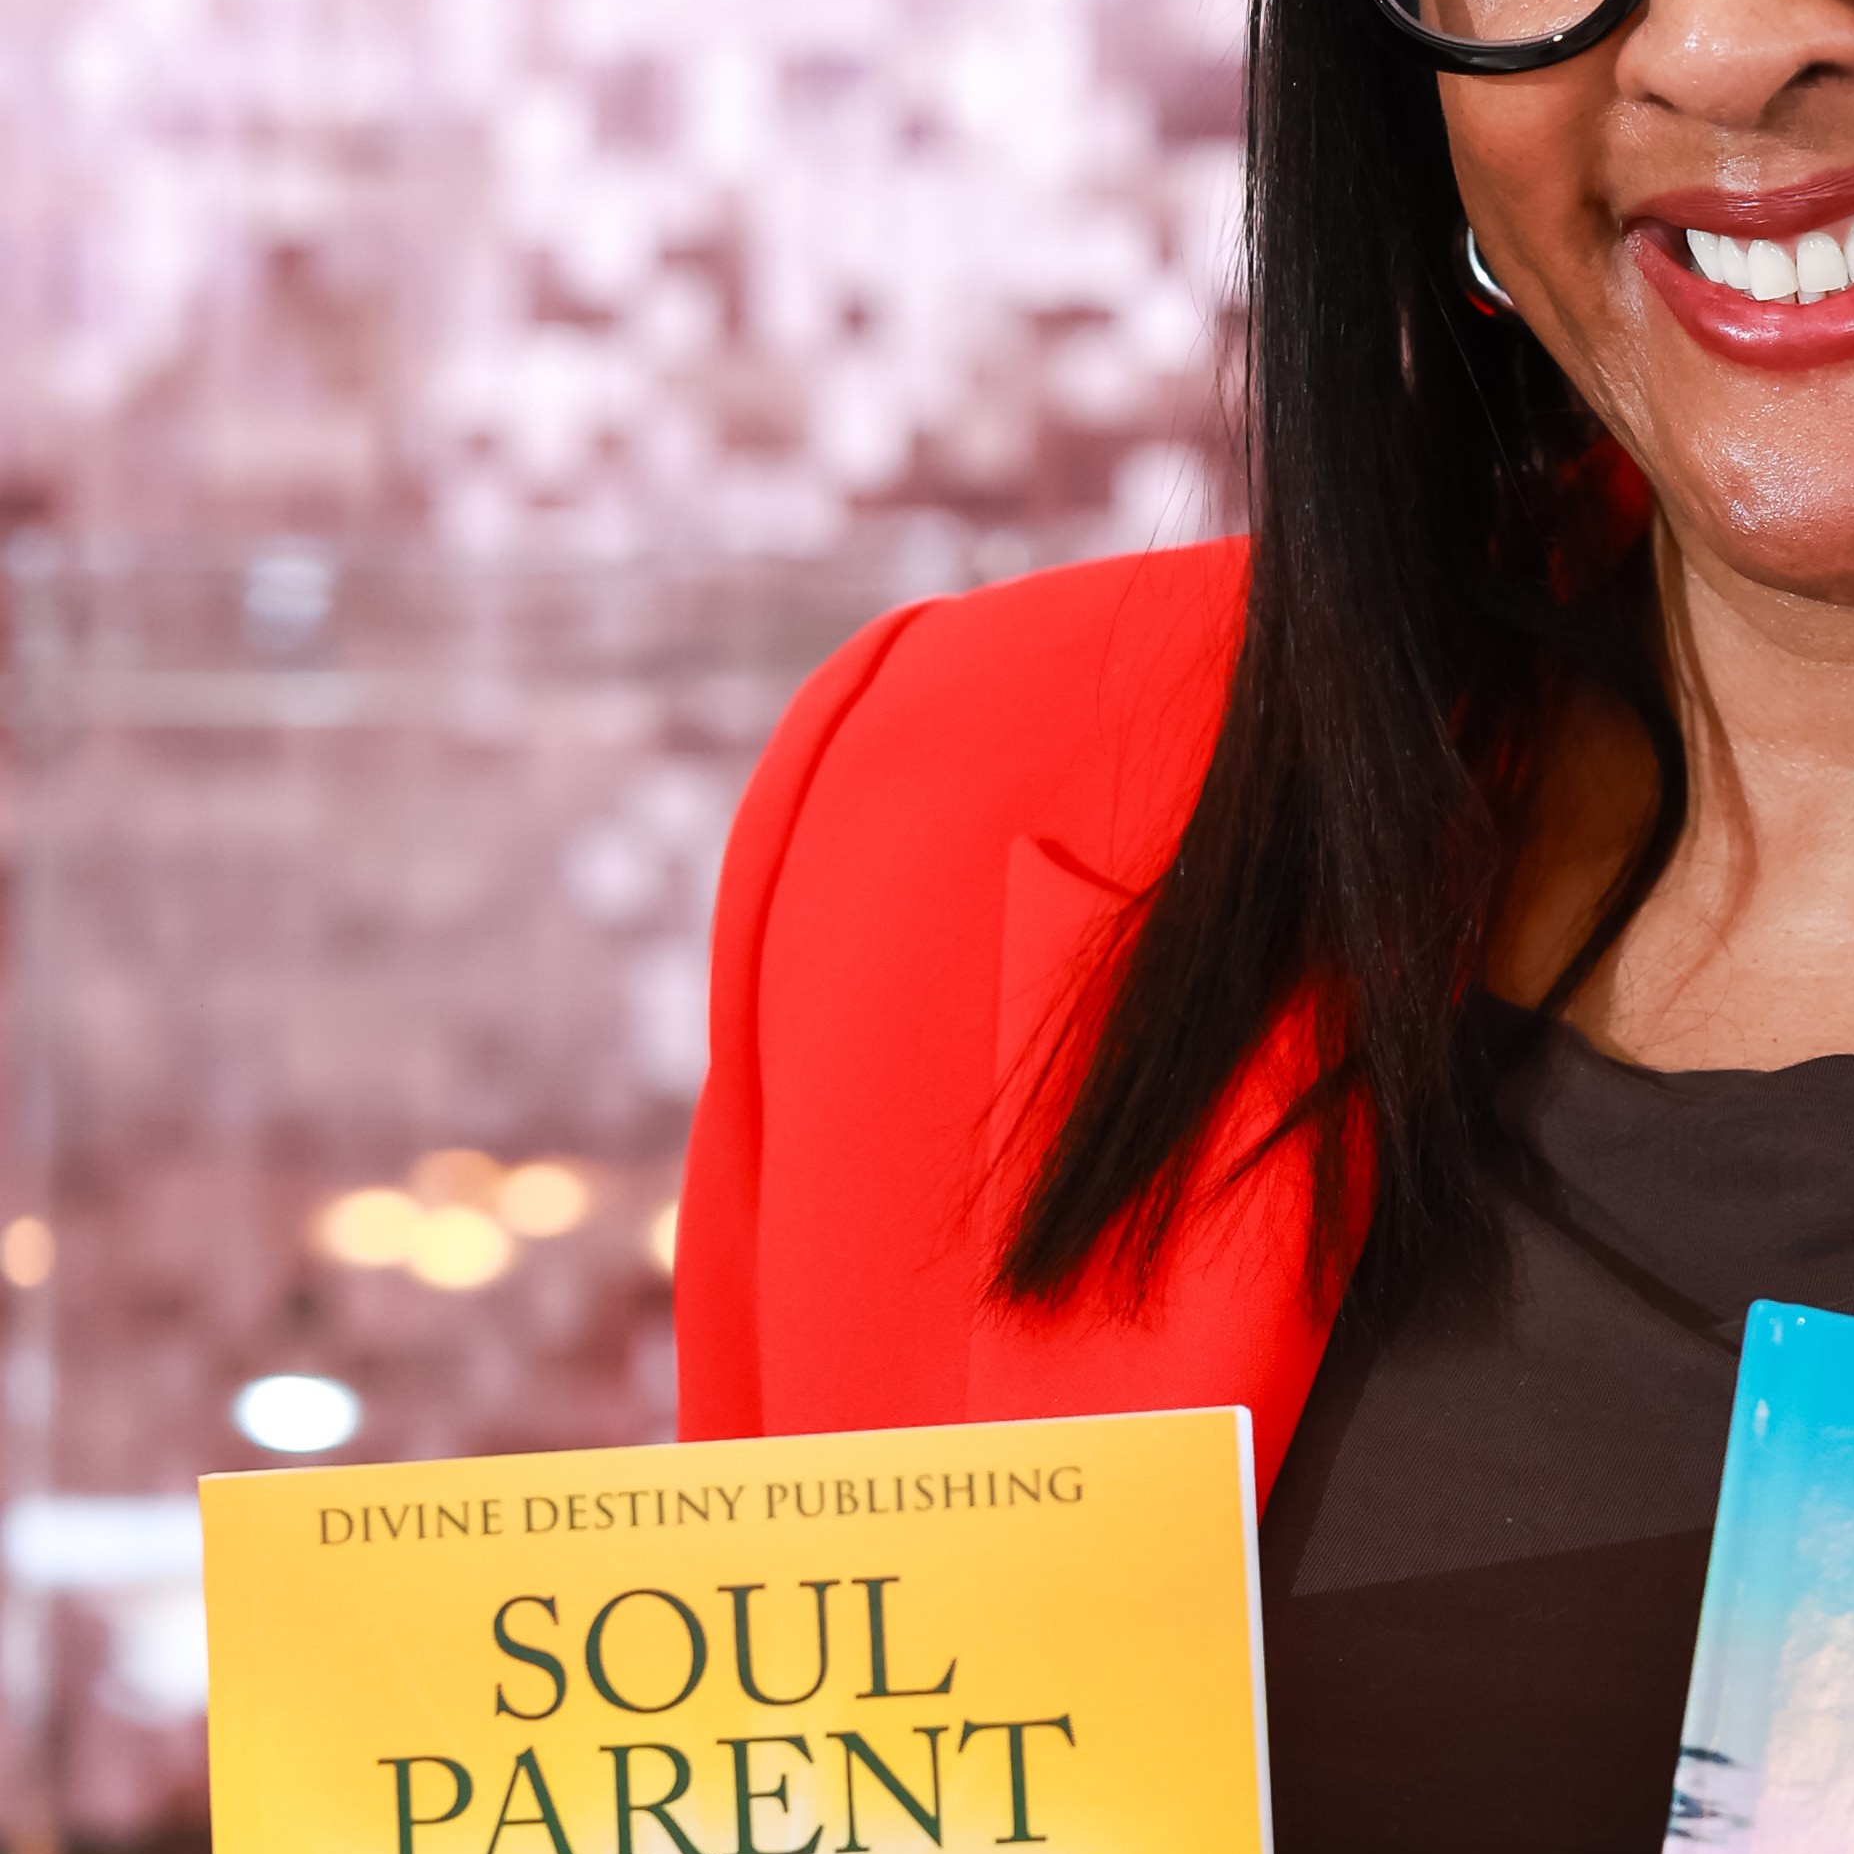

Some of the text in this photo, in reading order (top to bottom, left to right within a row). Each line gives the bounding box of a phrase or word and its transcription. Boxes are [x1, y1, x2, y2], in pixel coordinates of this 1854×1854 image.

[318, 1466, 1083, 1545] DIVINE DESTINY PUBLISHING
[493, 1576, 957, 1720] SOUL
